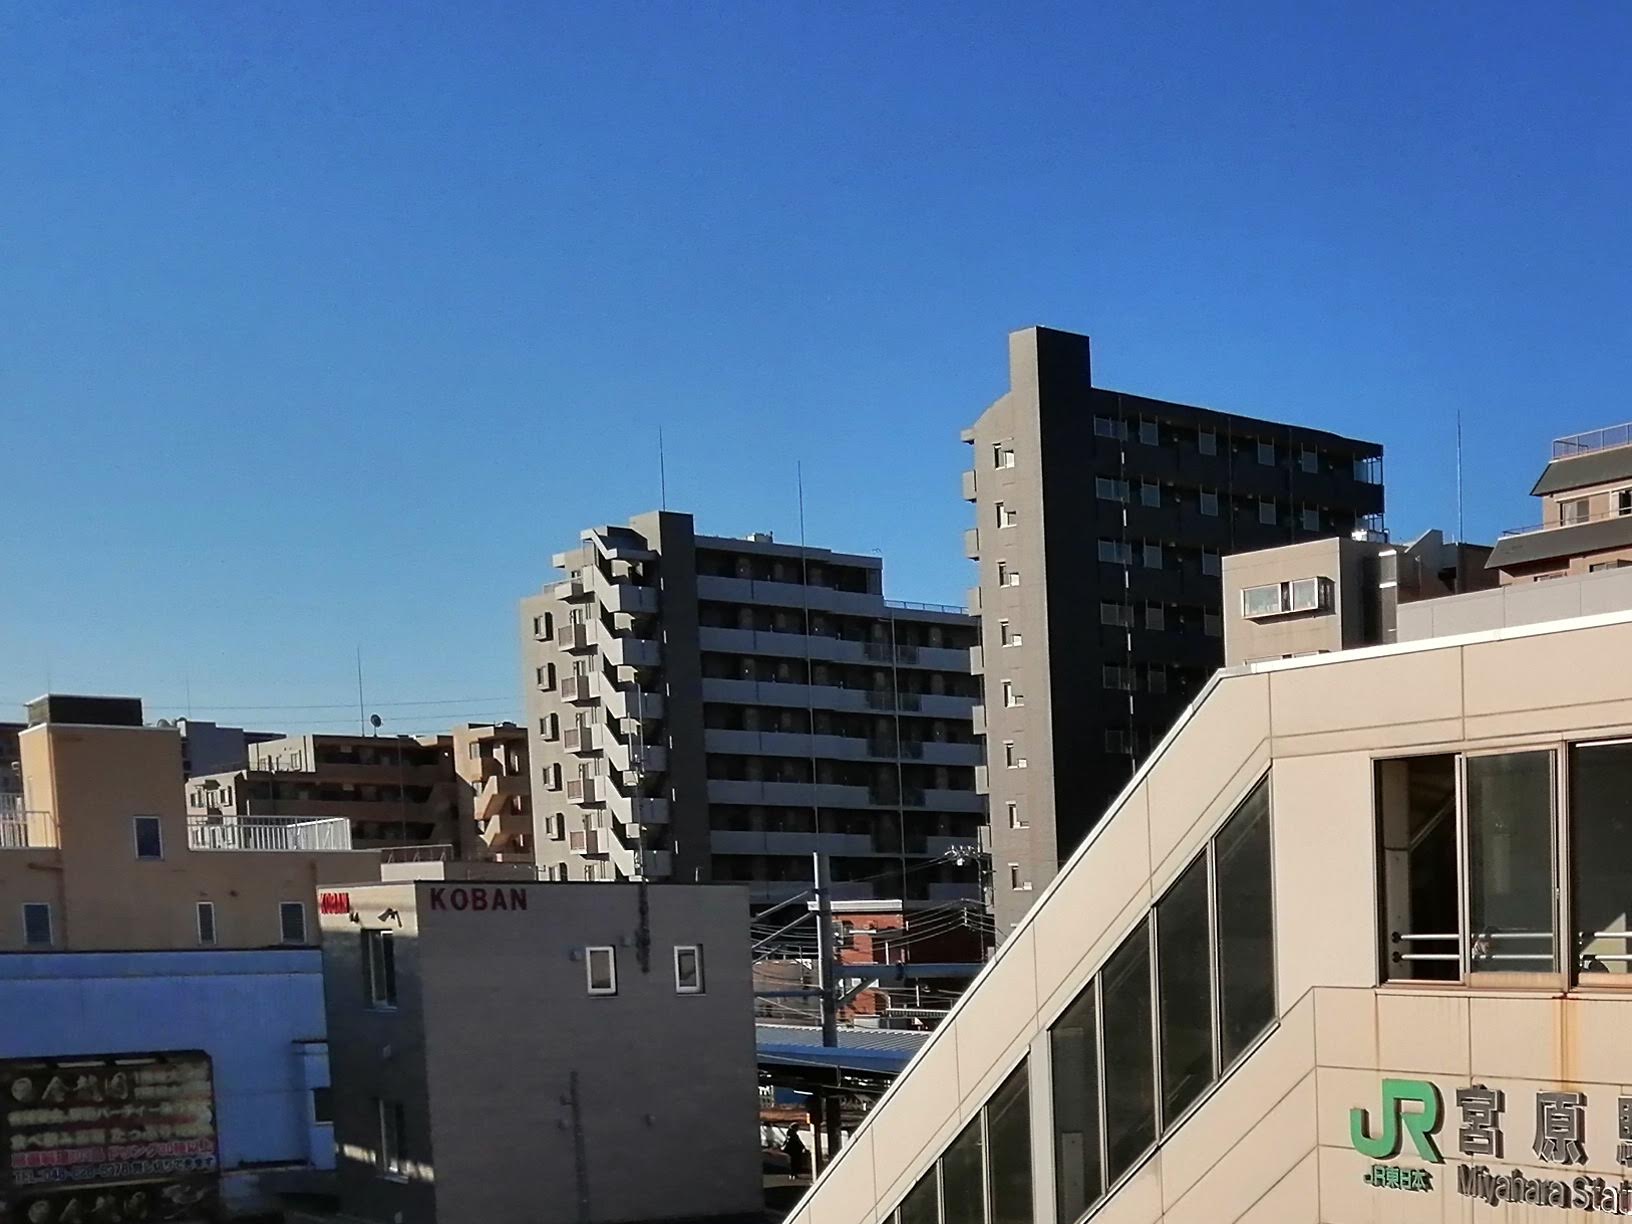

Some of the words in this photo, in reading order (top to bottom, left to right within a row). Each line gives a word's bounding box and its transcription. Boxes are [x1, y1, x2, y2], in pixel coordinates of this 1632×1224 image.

[430, 888, 527, 911] KOBAN
[1350, 1078, 1444, 1164] JR
[1362, 1164, 1434, 1192] JR東日本
[1457, 1164, 1572, 1207] Miyahara
